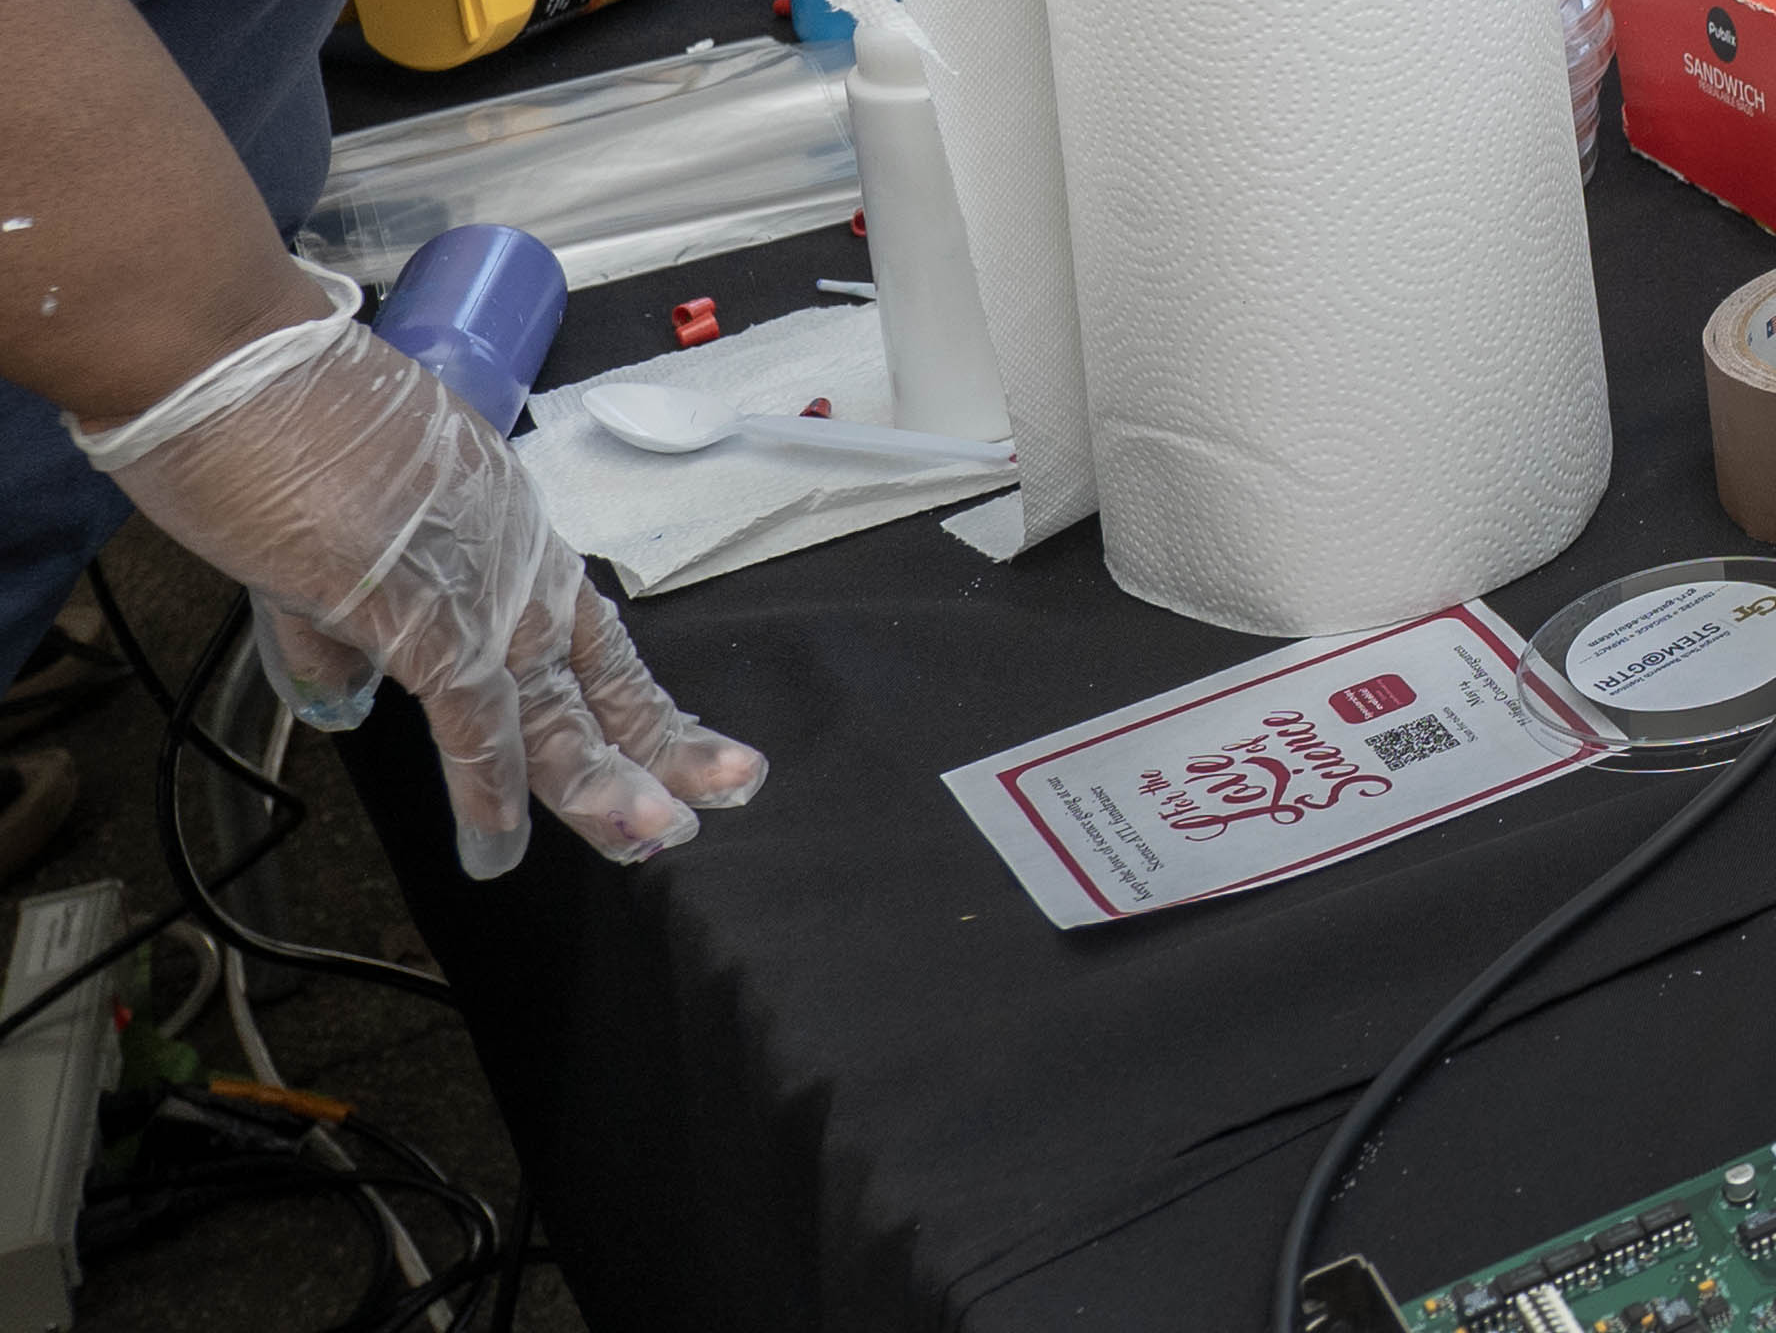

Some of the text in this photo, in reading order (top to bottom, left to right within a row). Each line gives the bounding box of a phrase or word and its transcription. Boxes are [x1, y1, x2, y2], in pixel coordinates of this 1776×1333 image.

[1683, 52, 1766, 113] SANDWICH
[1483, 677, 1508, 701] Crooks
[1593, 621, 1722, 693] STEM@GTRI
[1464, 689, 1484, 707] May
[1220, 734, 1271, 754] of
[1262, 710, 1393, 810] Science
[1137, 769, 1201, 822] For the
[1169, 754, 1306, 842] Love
[1046, 777, 1153, 901] Keep the love of science going at our
[1090, 786, 1164, 872] Science ATL fundraiser
